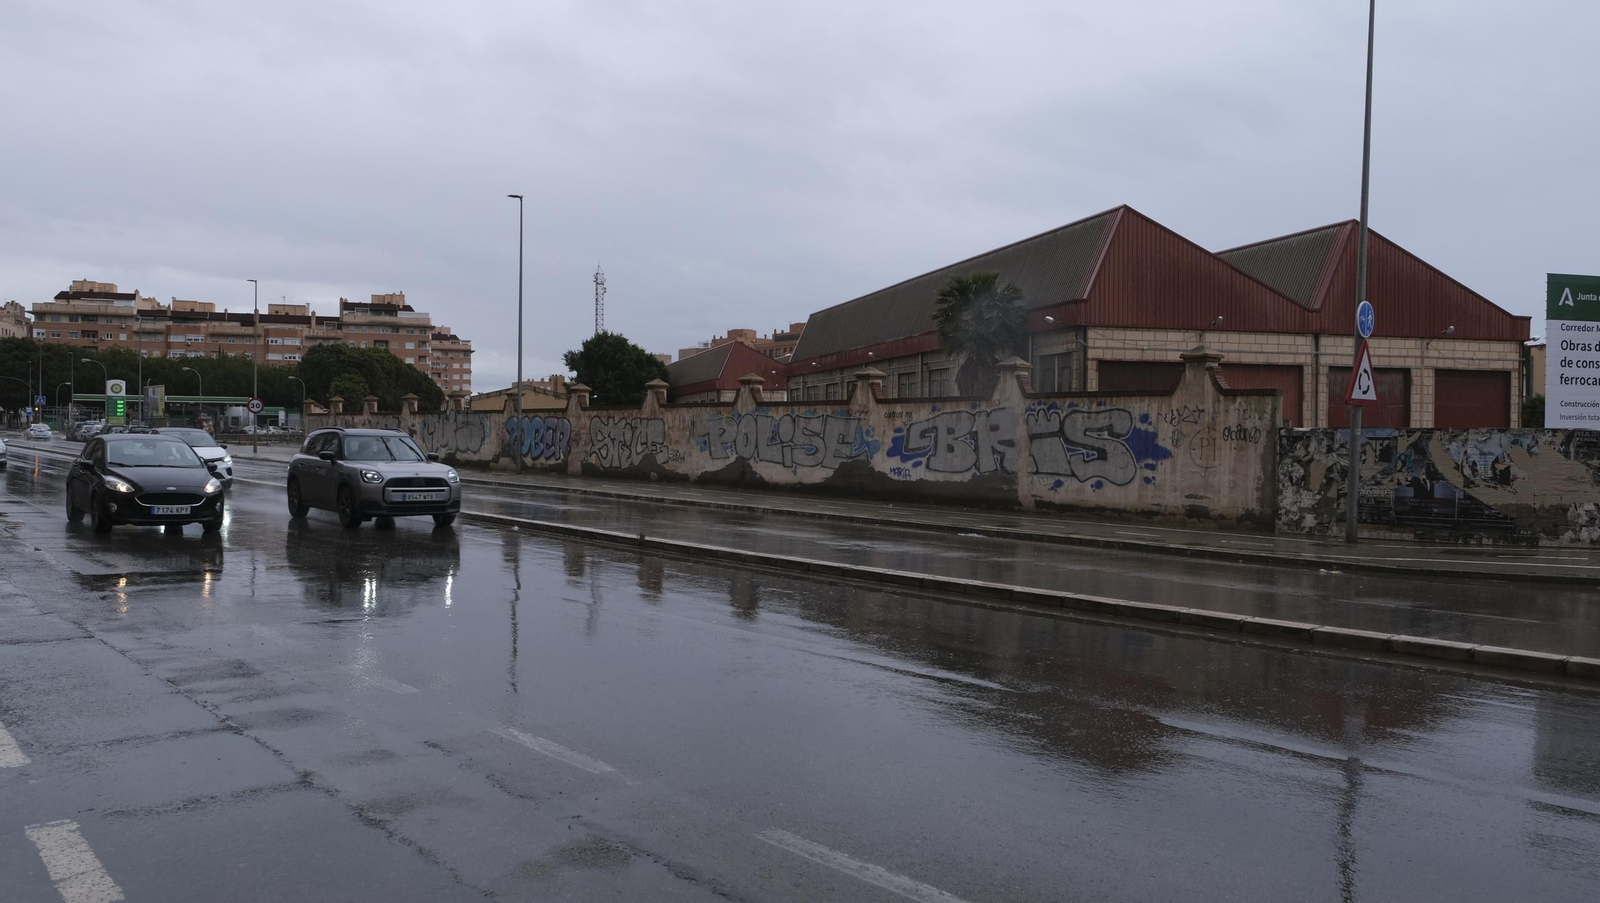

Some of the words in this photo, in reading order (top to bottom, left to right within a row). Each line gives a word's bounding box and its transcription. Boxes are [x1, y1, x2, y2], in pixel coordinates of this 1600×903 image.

[1576, 292, 1597, 301] Junta
[1560, 322, 1594, 332] Corredor
[1560, 339, 1592, 352] Obras
[1560, 356, 1573, 368] de
[1560, 400, 1600, 408] Construcción
[1559, 413, 1587, 421] Inversión
